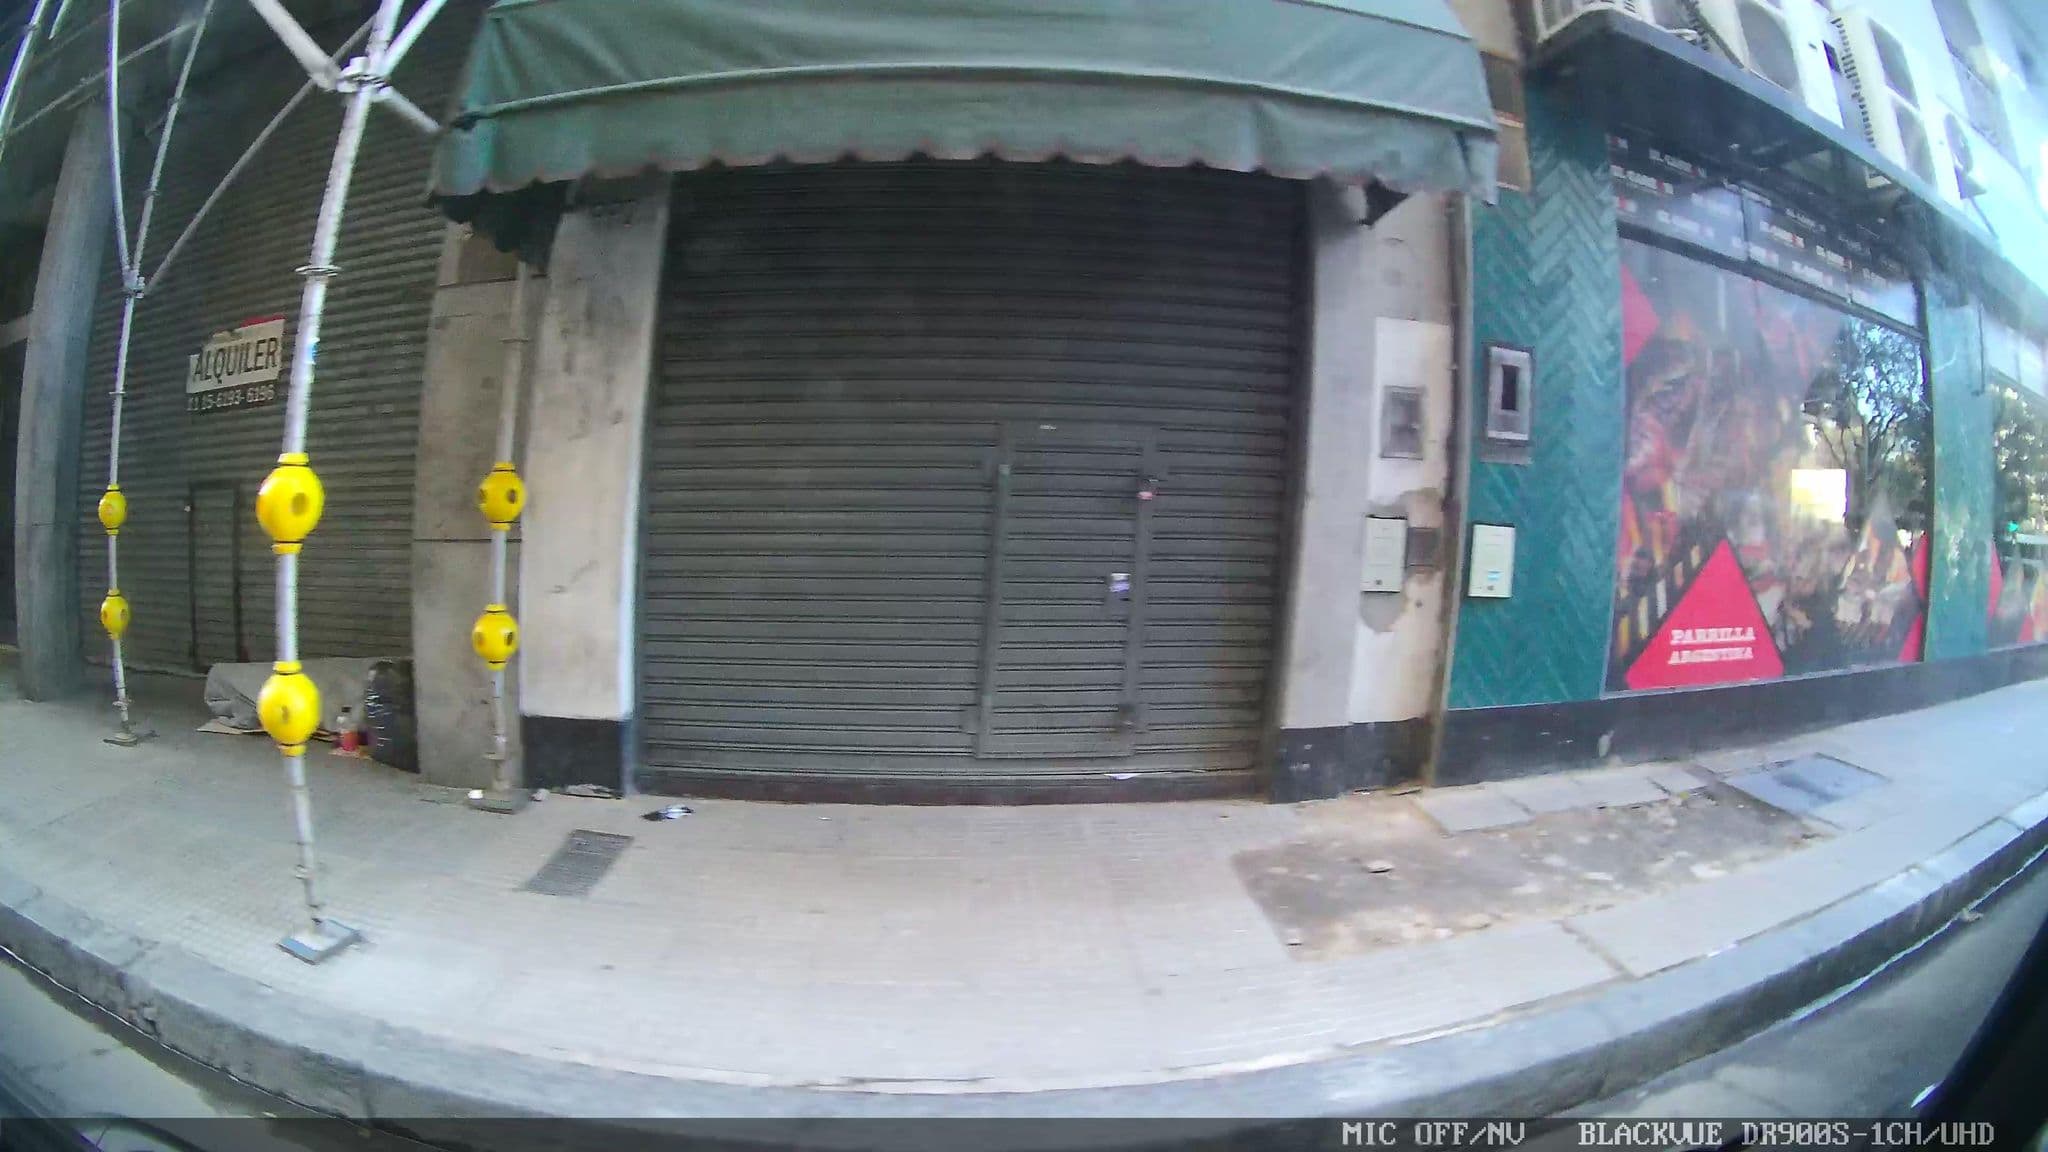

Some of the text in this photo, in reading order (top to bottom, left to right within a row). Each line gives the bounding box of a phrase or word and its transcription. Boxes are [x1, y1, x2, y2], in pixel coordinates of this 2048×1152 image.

[193, 337, 279, 384] ALQUILER
[1670, 627, 1756, 645] PARRILLA
[1668, 647, 1754, 665] ARGENTINA
